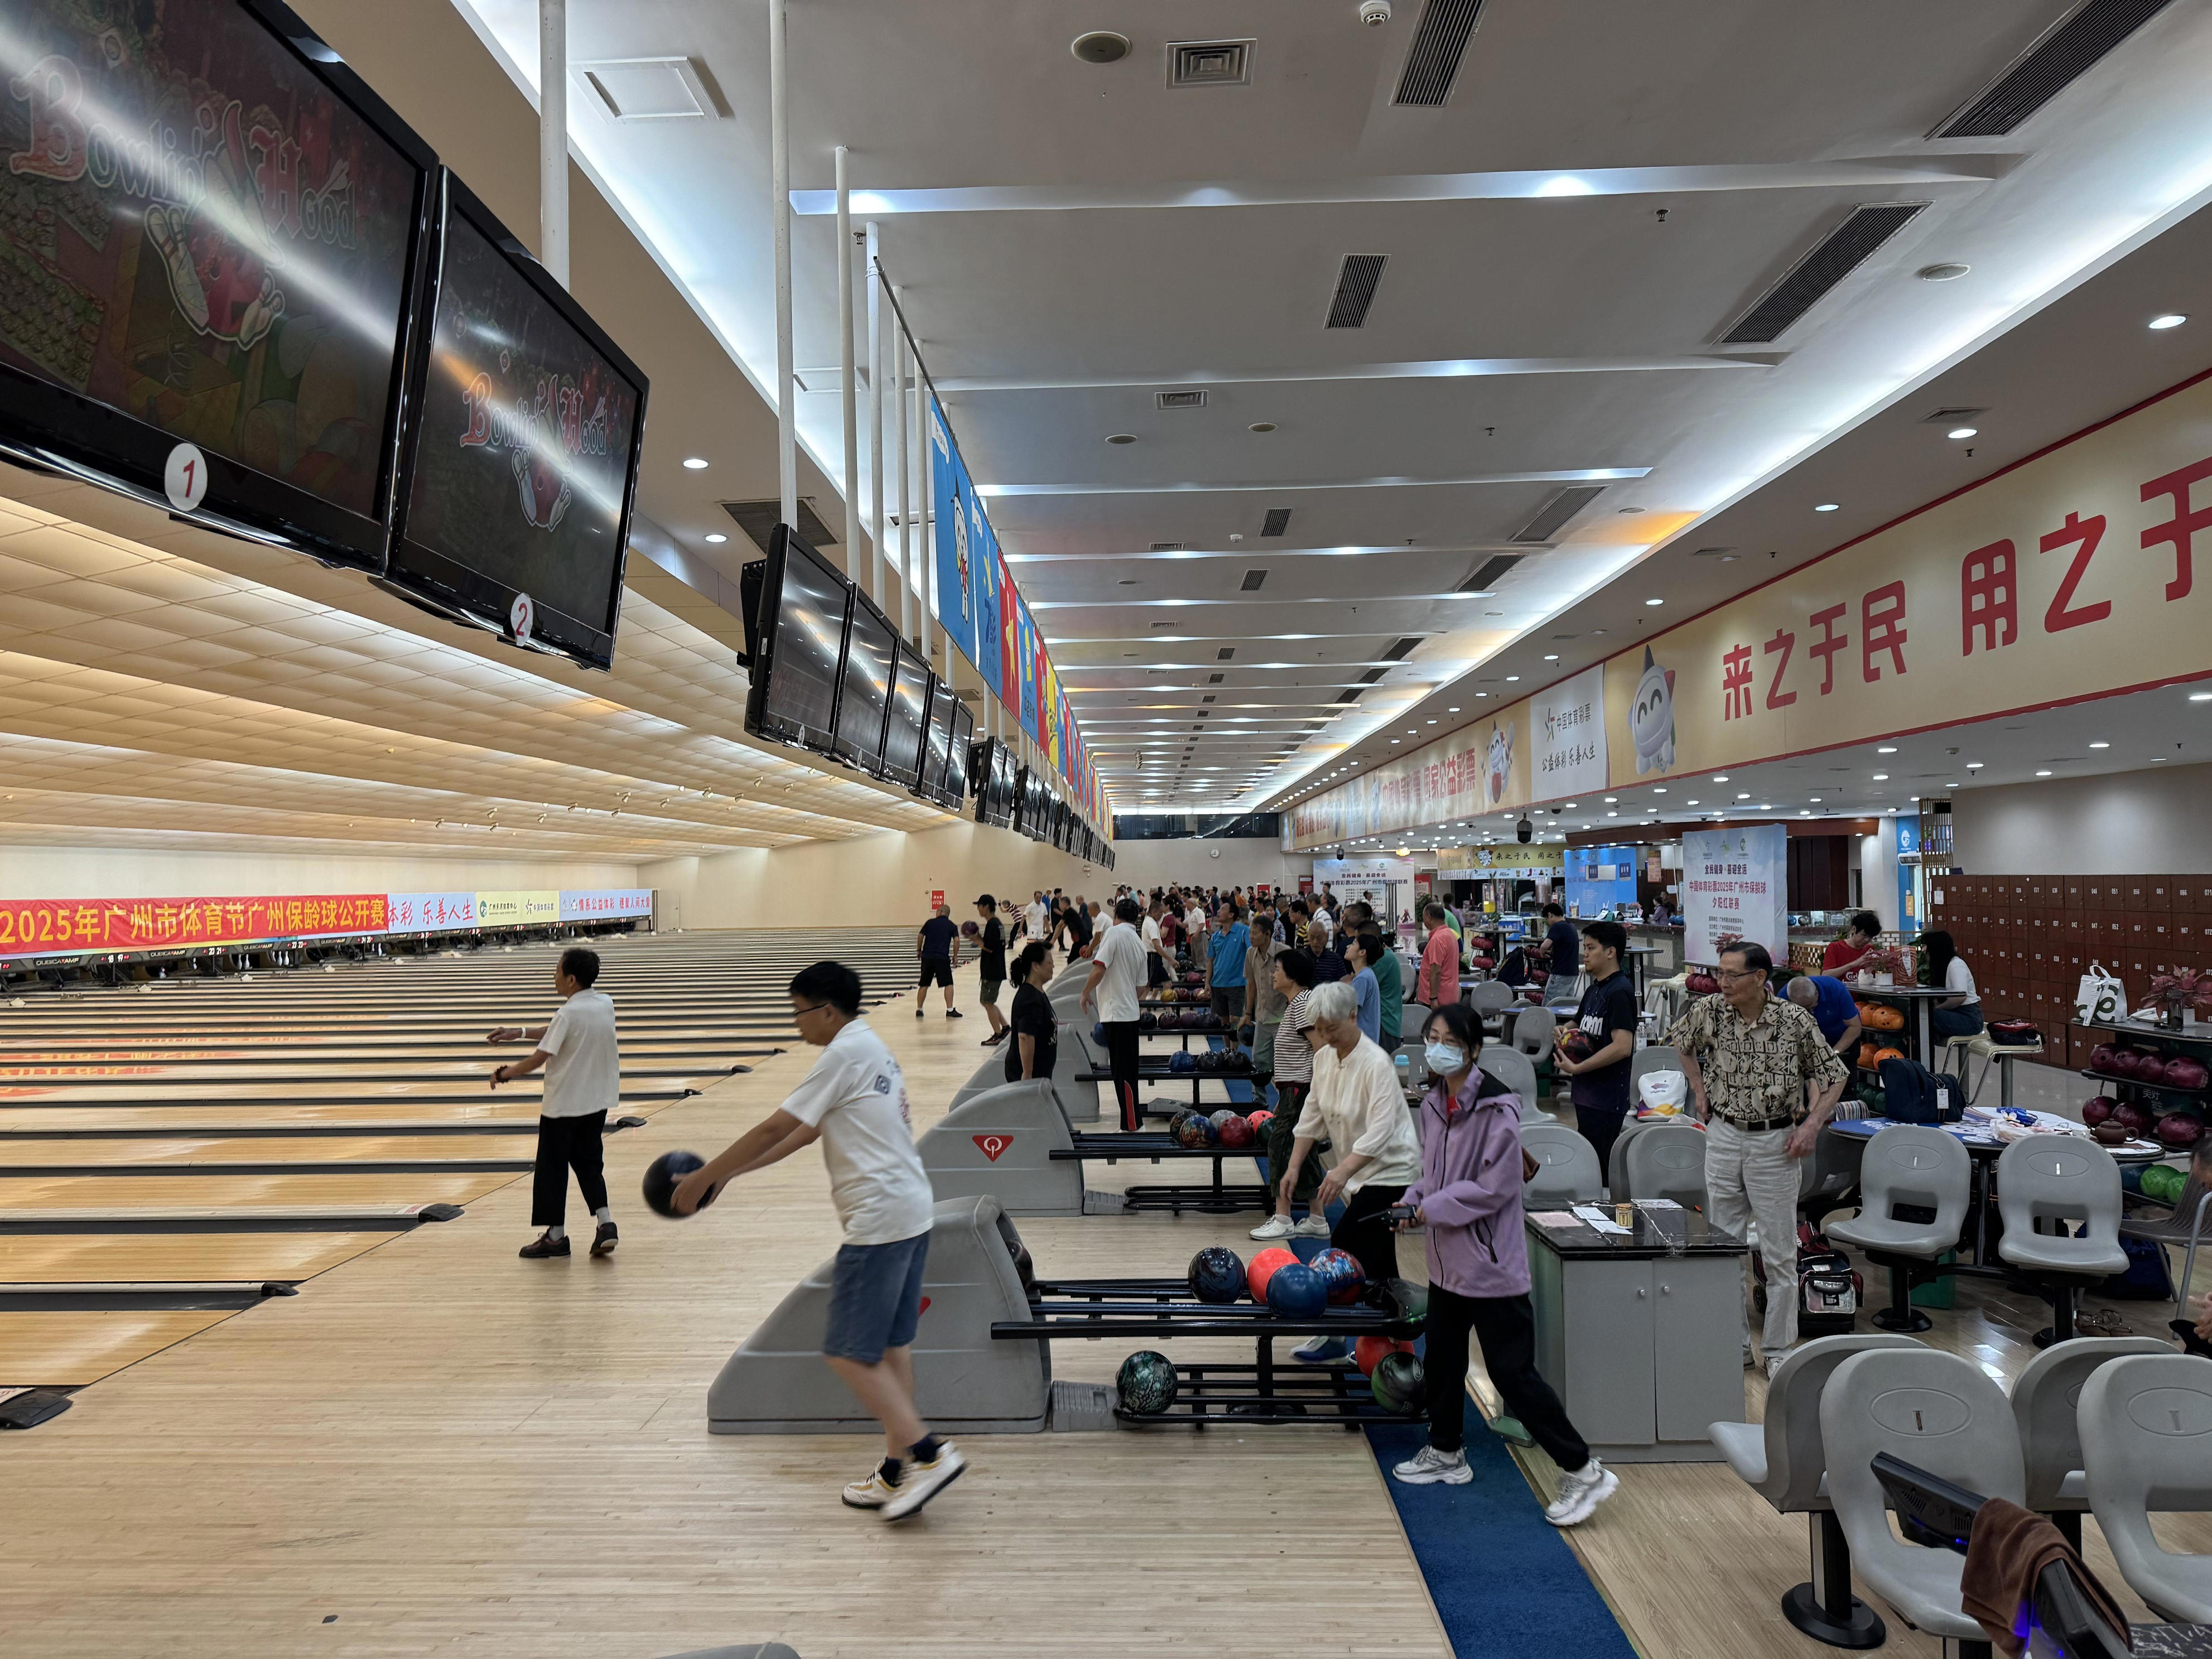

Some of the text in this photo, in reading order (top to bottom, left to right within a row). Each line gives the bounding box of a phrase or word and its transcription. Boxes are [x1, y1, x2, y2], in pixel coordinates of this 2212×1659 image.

[249, 125, 357, 249] Hood
[560, 387, 608, 455] Hood
[182, 459, 196, 499] 1
[1723, 456, 2212, 721] 来之于民 用之于
[514, 602, 528, 637] 2
[1557, 703, 1591, 732] 中国体育彩票
[1424, 747, 1476, 802] 国家公益彩票
[1496, 852, 1530, 860] 来之于民
[1705, 864, 1747, 875] 全民健身 喜迎全运
[1689, 880, 1766, 895] 中国体育彩票2025年广州市保龄球
[1713, 897, 1739, 910] 夕阳红联赛
[0, 899, 385, 943] 2025年广州市体育节广州保龄球公开赛
[423, 898, 473, 925] 乐善人生
[117, 954, 123, 962] 19
[209, 947, 215, 956] 20
